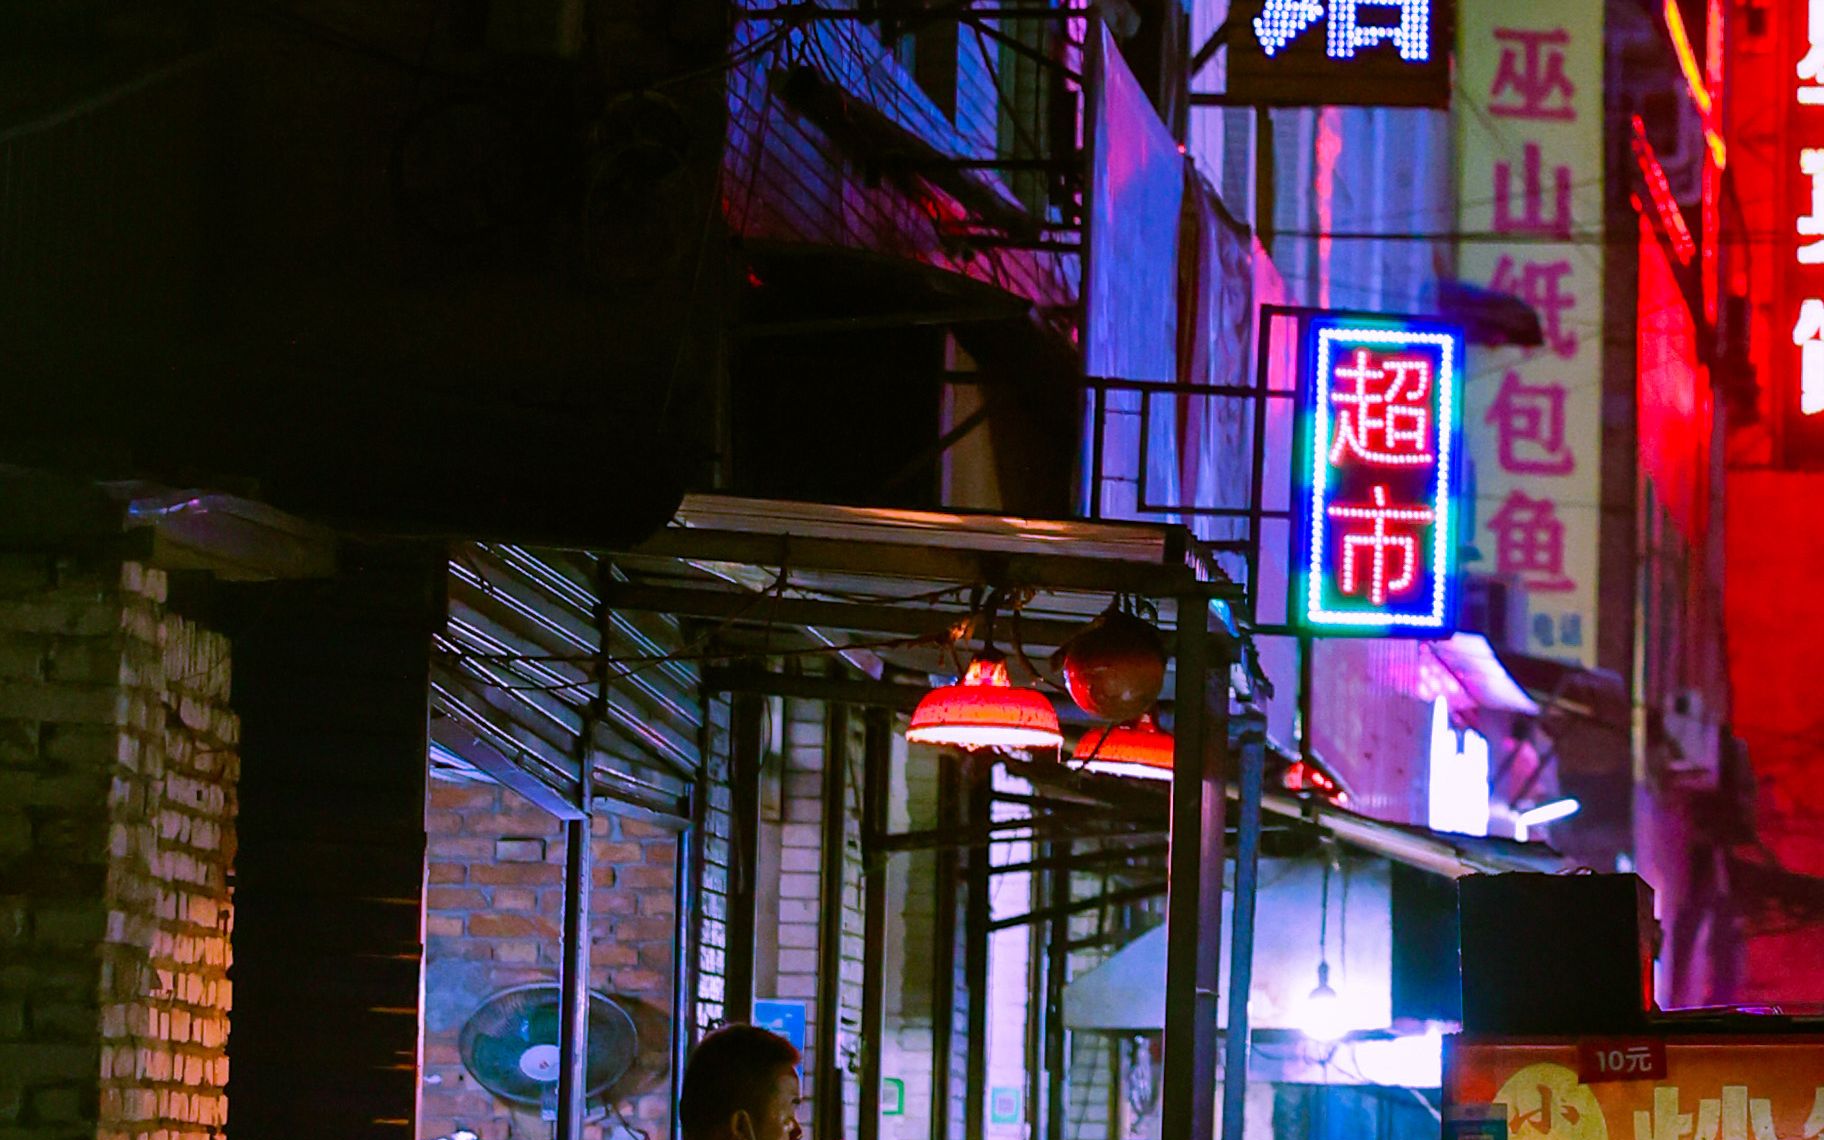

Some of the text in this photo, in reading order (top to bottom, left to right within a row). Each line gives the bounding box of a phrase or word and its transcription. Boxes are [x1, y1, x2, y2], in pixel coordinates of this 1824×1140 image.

[1488, 26, 1579, 593] 巫山纸包鱼
[1329, 349, 1434, 605] 超市
[1597, 1046, 1652, 1073] 10元
